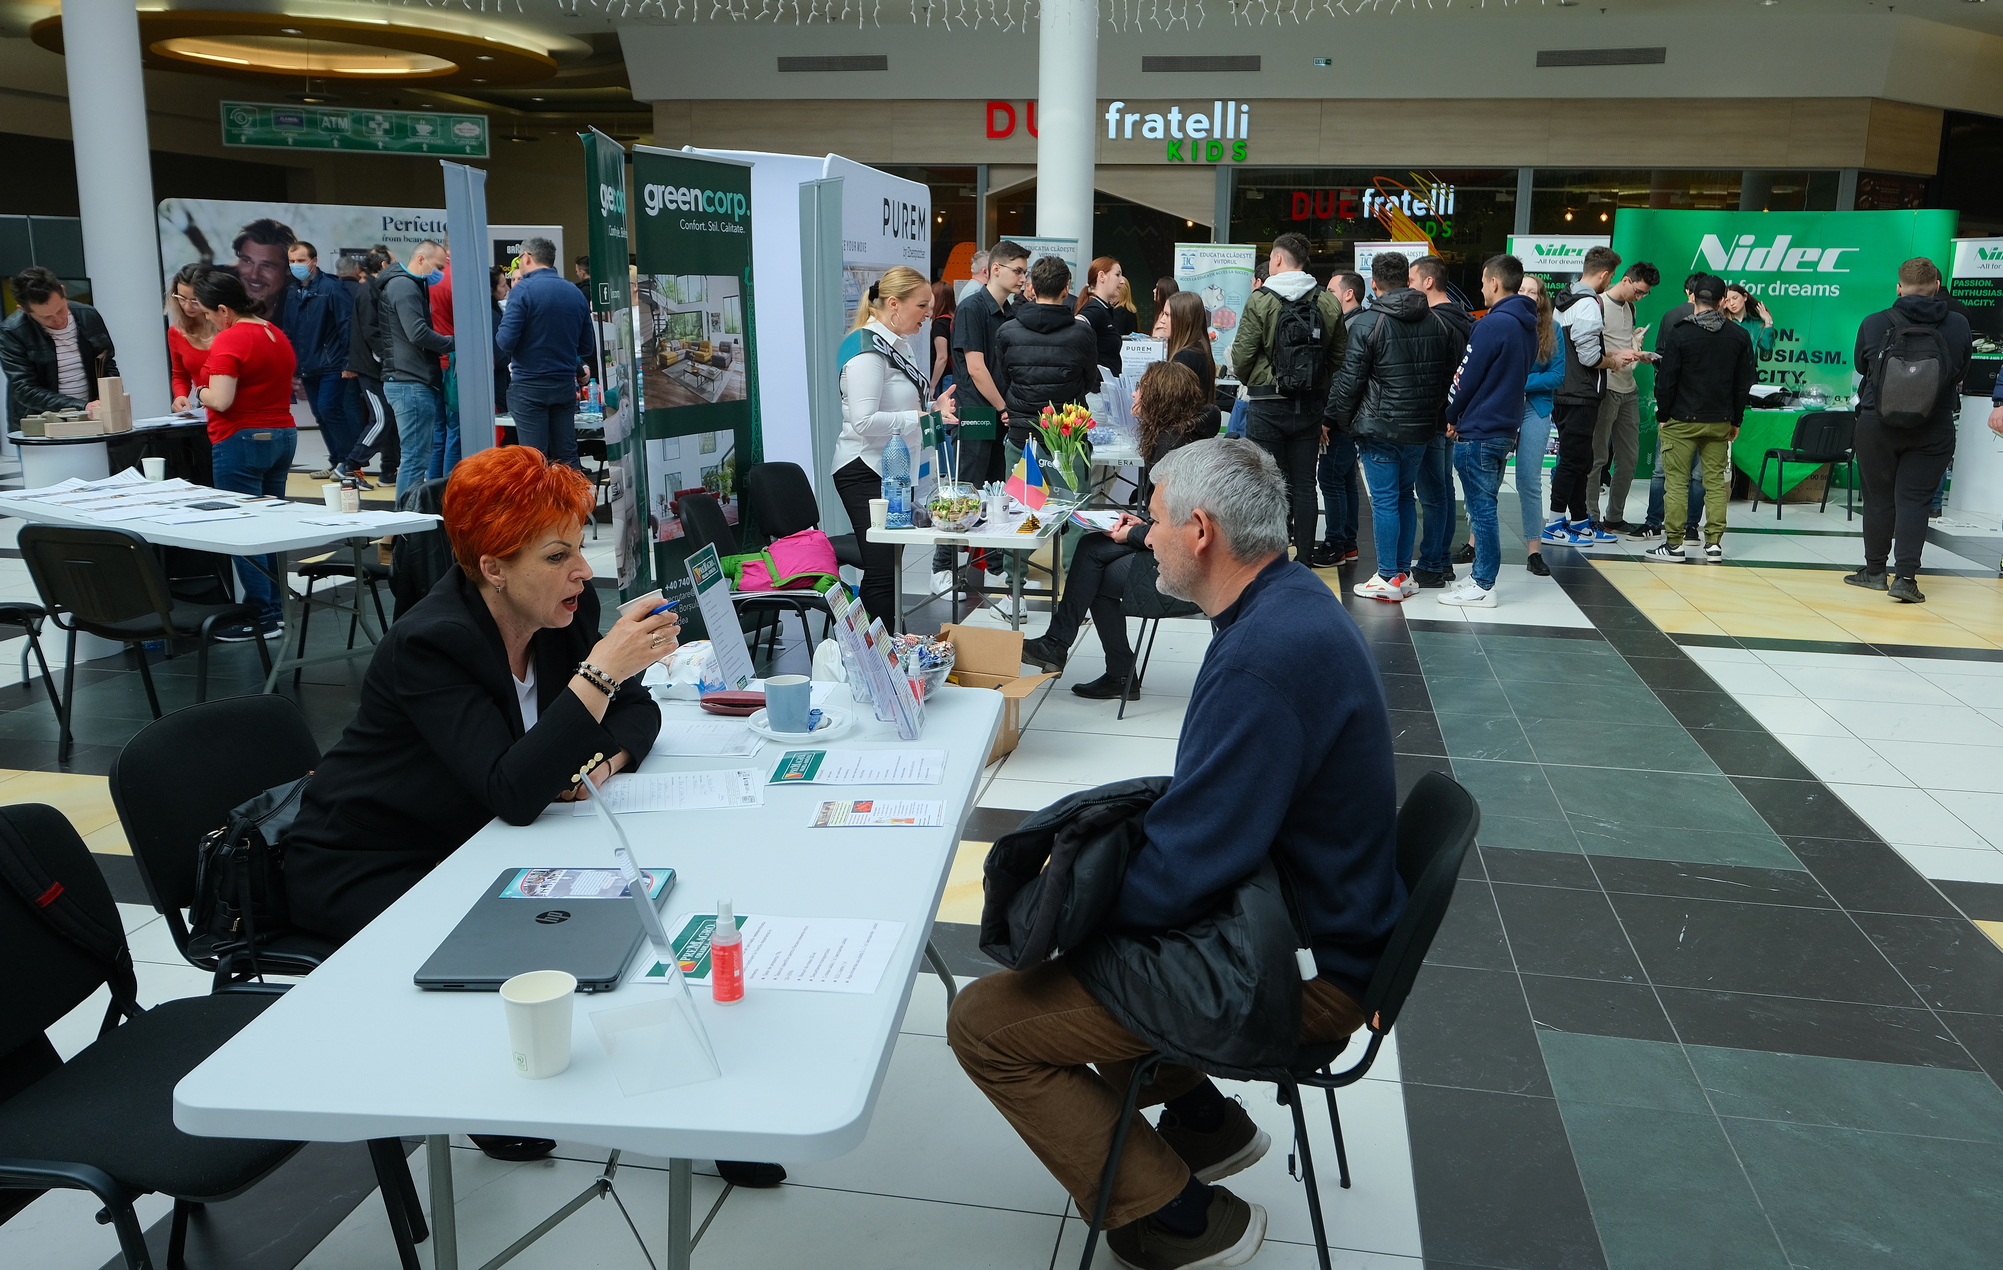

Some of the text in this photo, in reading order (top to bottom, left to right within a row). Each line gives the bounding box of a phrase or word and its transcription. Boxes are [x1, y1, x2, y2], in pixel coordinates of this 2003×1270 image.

[321, 116, 348, 130] ATM
[1105, 100, 1249, 140] fratelli
[1166, 140, 1247, 161] KIDS
[644, 183, 750, 221] greencorp.
[1291, 182, 1455, 220] DUE fratelli
[679, 219, 745, 234] Confort. Stil. Calitate.
[883, 197, 926, 242] PUREM
[382, 234, 401, 242] from
[506, 243, 521, 254] BRA
[1690, 233, 1860, 272] Nidec
[1768, 280, 1840, 297] dreams
[1953, 279, 1994, 287] PASSION.
[1952, 289, 2003, 297] ENTHUSIAS
[1958, 298, 1996, 307] NACITY.
[1759, 349, 1847, 365] USIASM.
[1757, 369, 1807, 384] CITY.
[960, 419, 992, 427] greencorp.
[665, 577, 690, 591] +40 740
